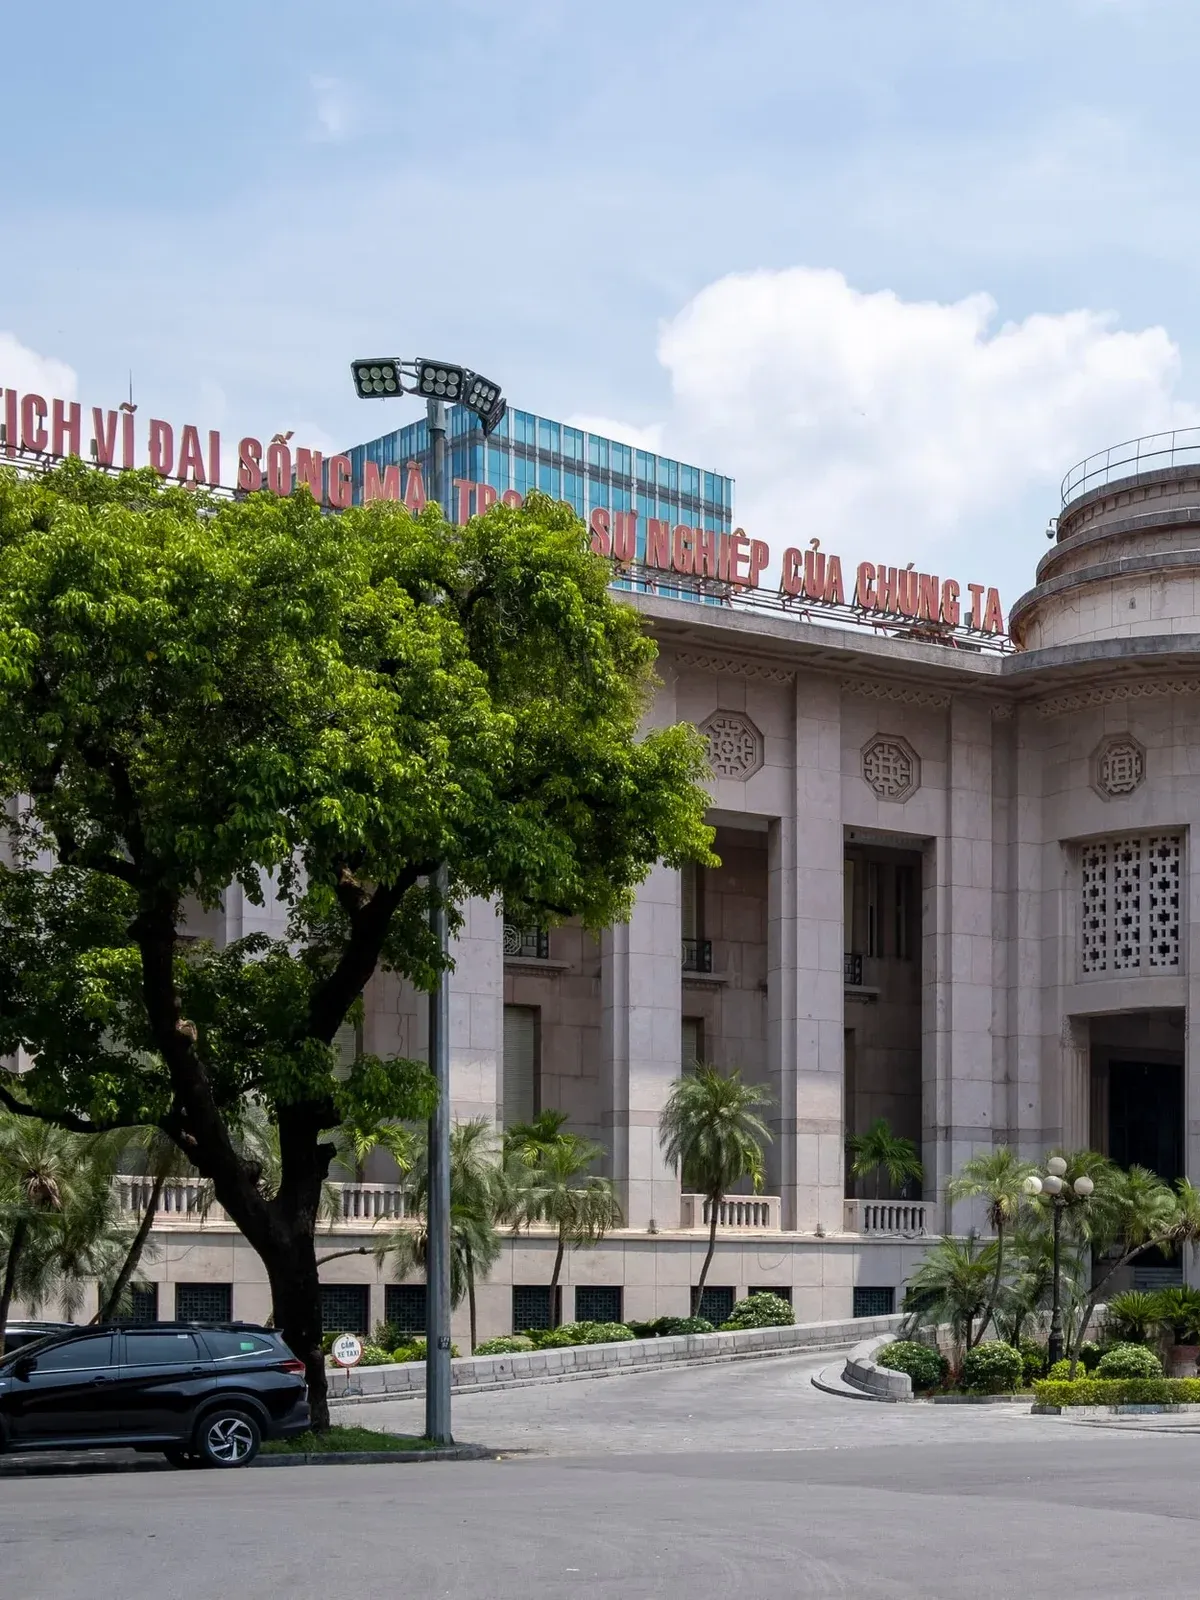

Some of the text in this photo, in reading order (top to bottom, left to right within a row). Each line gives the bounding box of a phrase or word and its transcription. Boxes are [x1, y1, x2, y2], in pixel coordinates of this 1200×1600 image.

[0, 387, 81, 459] ỊCH
[92, 402, 138, 469] VĨ
[148, 418, 220, 491] ĐẠI
[239, 431, 352, 508] SỐNG
[588, 507, 638, 570] SỰ
[646, 527, 770, 593] NGHIỆP
[782, 537, 845, 604] CỦA
[856, 562, 960, 626] CHÚNG
[968, 583, 1004, 634] TA
